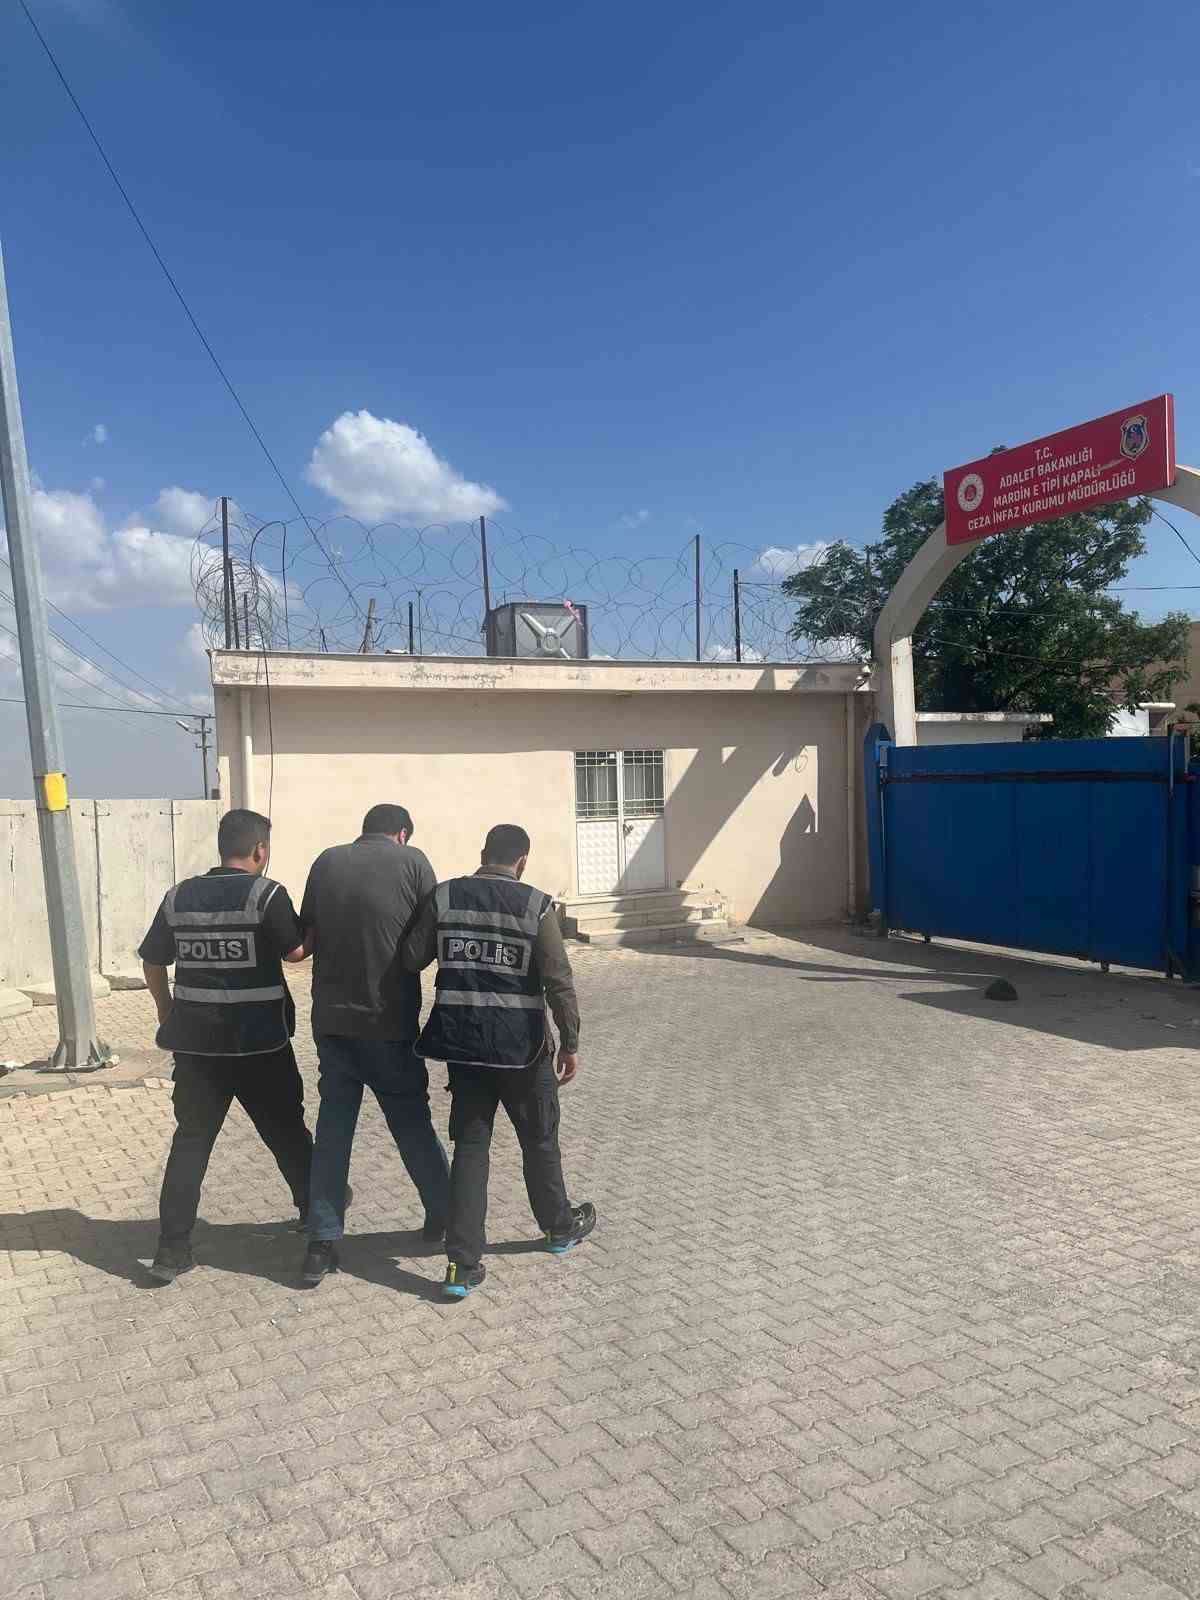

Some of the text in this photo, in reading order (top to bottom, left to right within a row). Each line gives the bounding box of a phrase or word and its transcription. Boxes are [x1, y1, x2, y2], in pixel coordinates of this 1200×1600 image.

[999, 448, 1093, 489] ADALET BAKANLIĞI
[1035, 447, 1053, 460] T.C.
[968, 468, 1136, 531] CEZA İNFAZ KURUMU MÜDÜRLÜĞÜ
[993, 486, 1031, 508] MARDİN
[1033, 484, 1039, 497] E
[1040, 476, 1060, 495] TİPİ
